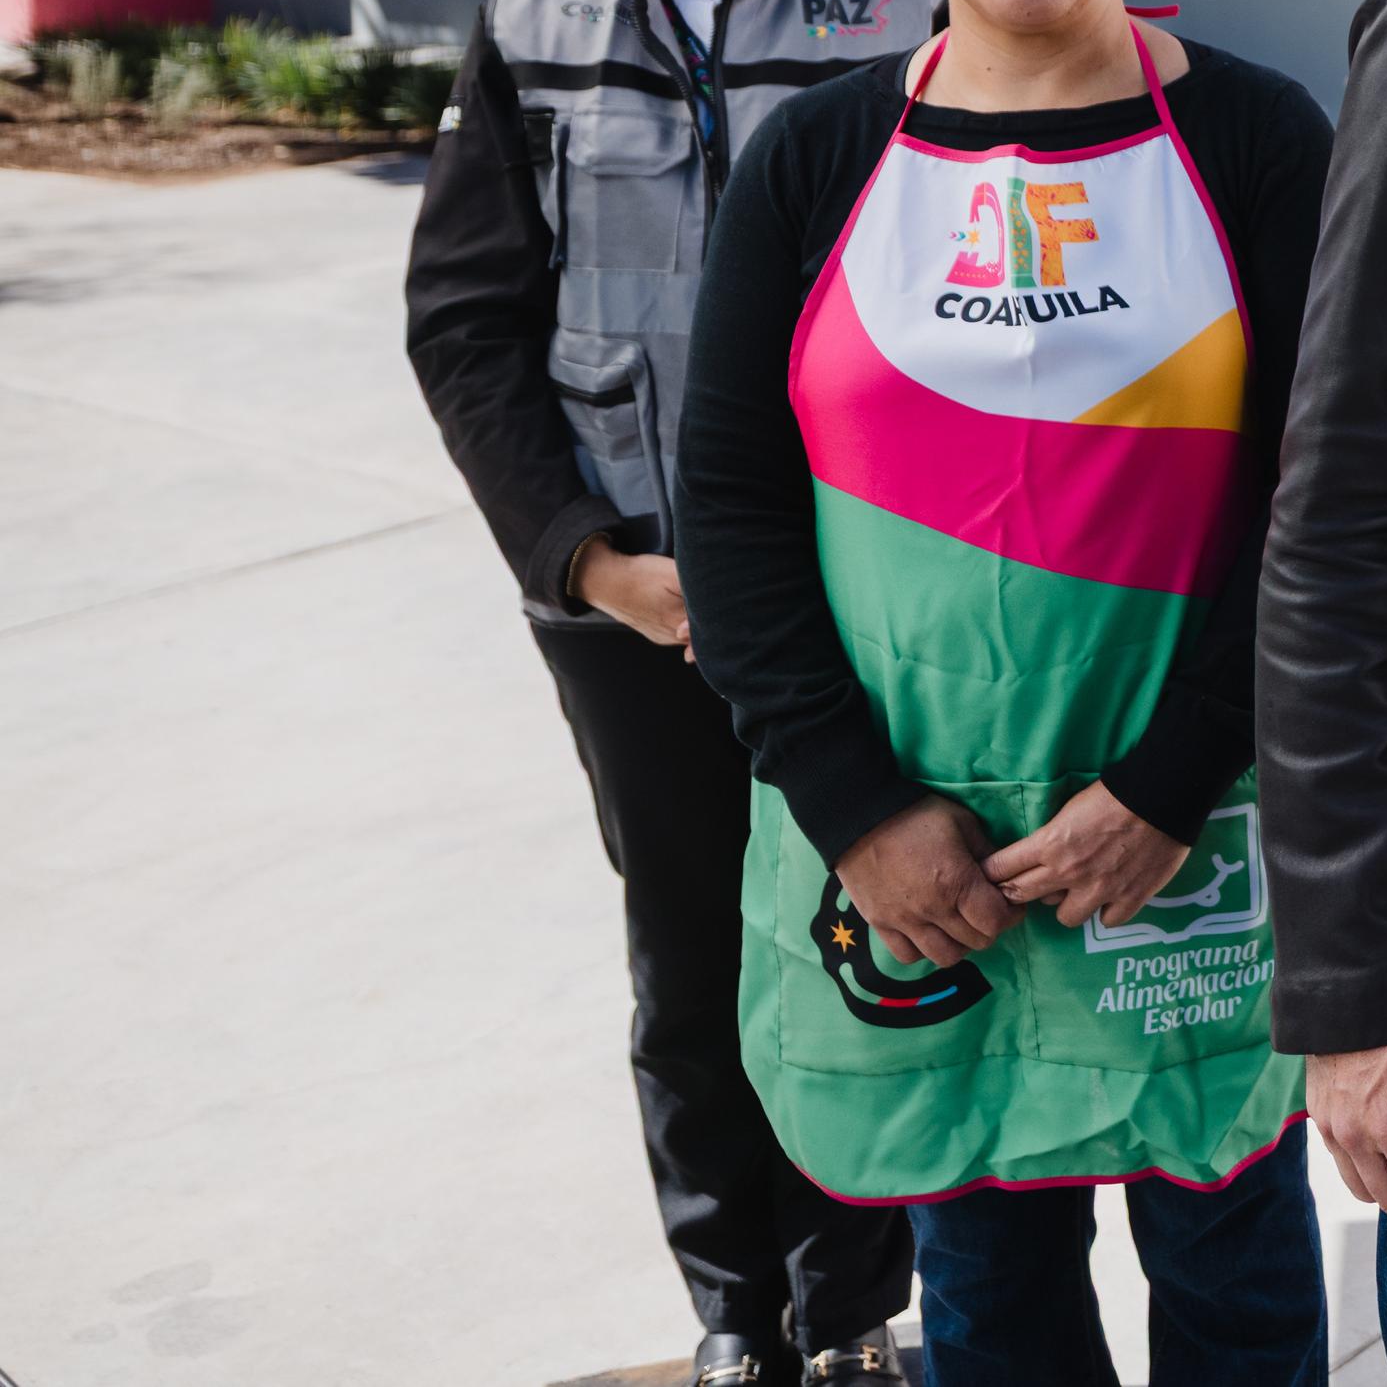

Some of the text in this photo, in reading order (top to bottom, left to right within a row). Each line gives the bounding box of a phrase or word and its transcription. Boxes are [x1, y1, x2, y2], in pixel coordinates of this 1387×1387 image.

[945, 176, 1099, 289] DIF
[934, 284, 1130, 327] COAHUILA
[1115, 938, 1259, 984] Programa
[1143, 995, 1242, 1035] Escolar
